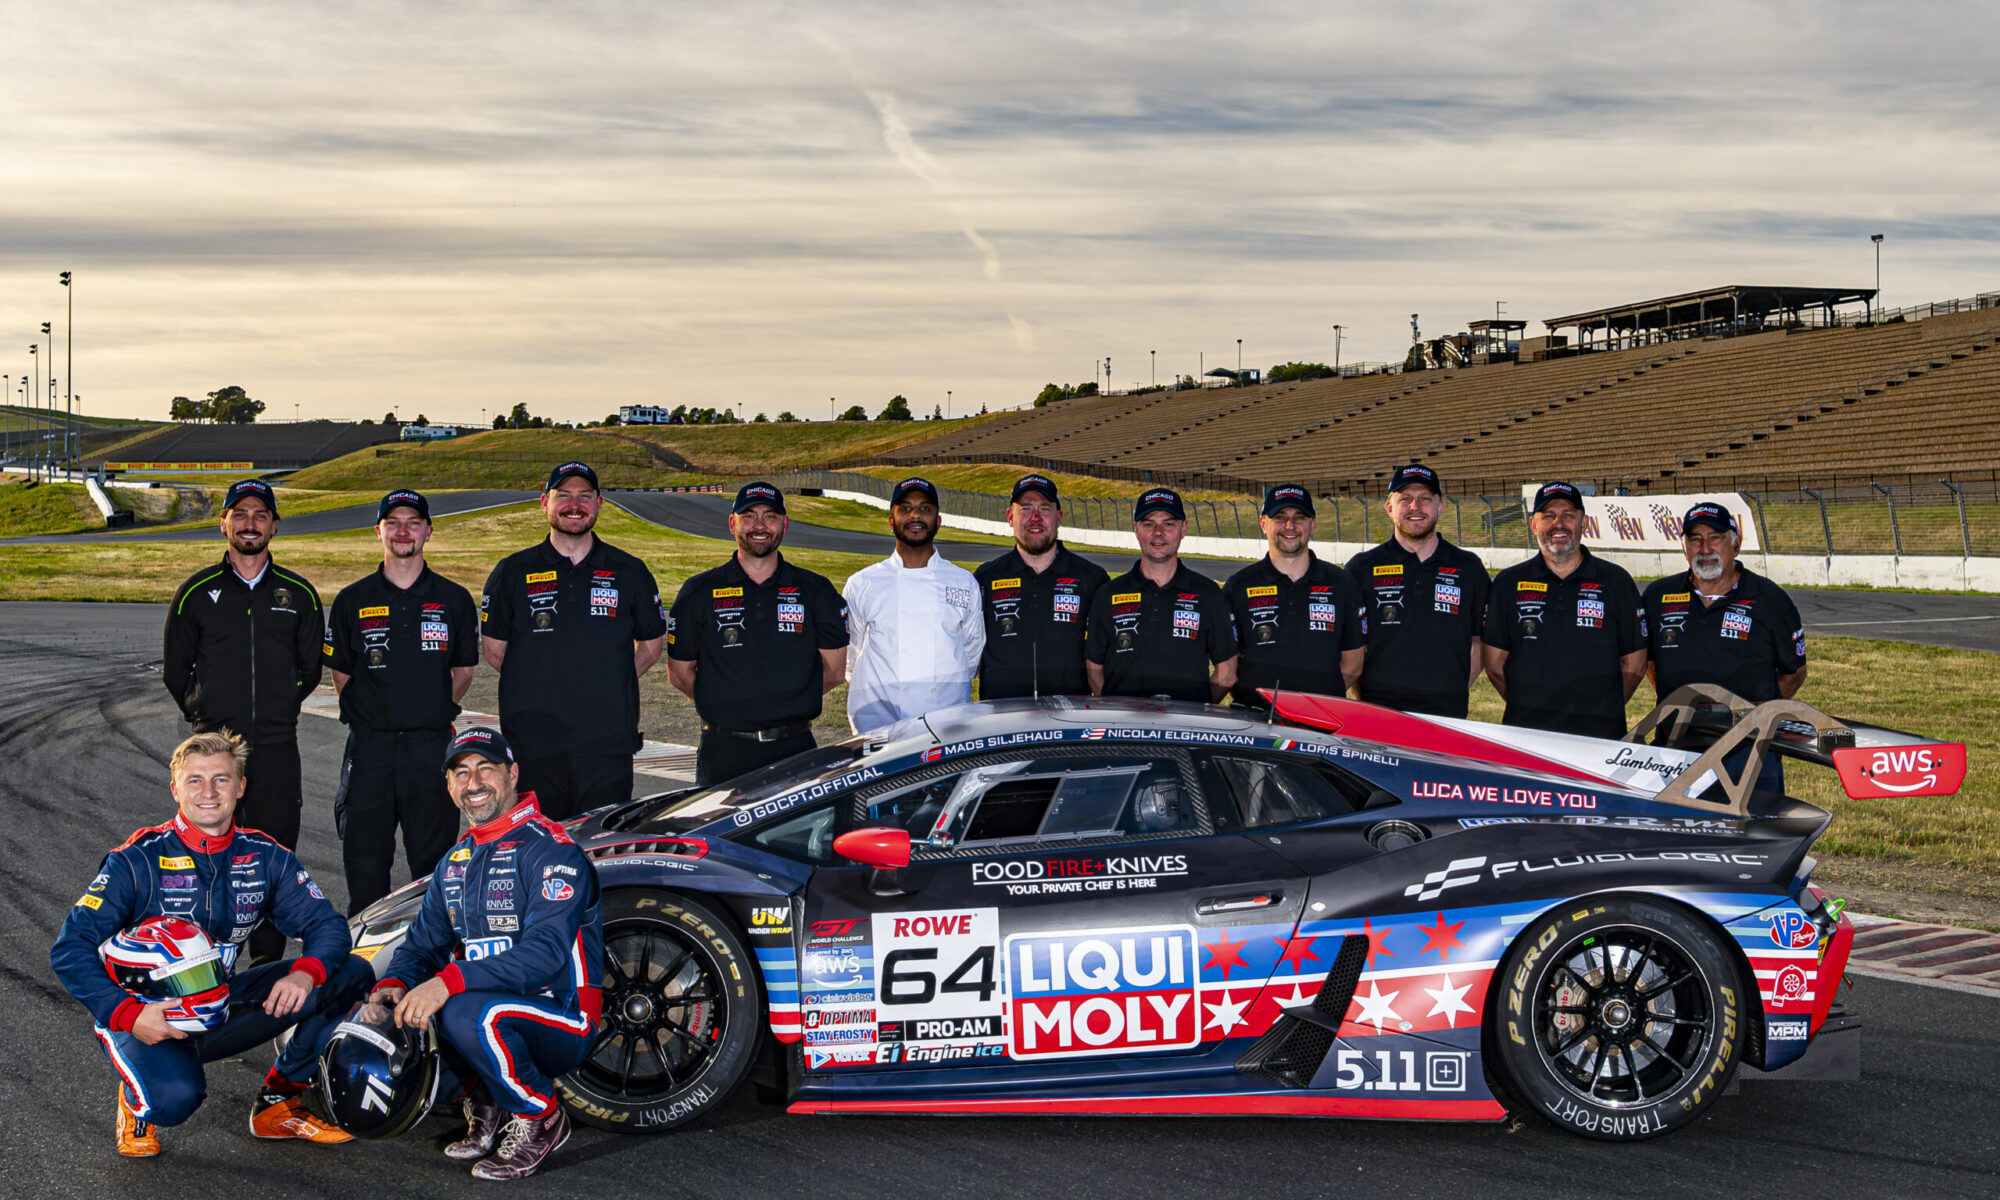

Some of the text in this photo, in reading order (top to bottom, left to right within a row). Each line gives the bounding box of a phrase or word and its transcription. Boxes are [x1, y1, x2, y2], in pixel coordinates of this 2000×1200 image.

[560, 462, 588, 473] CHICAGO
[1402, 468, 1432, 477] CHICAGO
[236, 482, 266, 490] CHICAGO
[746, 486, 776, 496] CHICAGO
[388, 492, 419, 502] CHICAGO
[1145, 492, 1174, 501] CHICAGO
[1274, 488, 1304, 496] CHICAGO
[592, 589, 616, 598] LIQUI
[1437, 586, 1459, 595] LIQUI
[592, 597, 617, 606] MOLY
[1056, 596, 1078, 604] LIQUI
[1436, 594, 1458, 603] MOLY
[1056, 604, 1079, 612] MOLY
[1311, 605, 1334, 613] LIQUI
[1580, 602, 1602, 610] LIQUI
[780, 612, 802, 621] MOLY
[1176, 612, 1198, 620] LIQUI
[1310, 612, 1334, 621] MOLY
[1579, 608, 1602, 617] MOLY
[1175, 619, 1199, 628] MOLY
[1726, 614, 1750, 624] LIQUI
[424, 623, 446, 632] LIQUI
[1724, 620, 1750, 632] MOLY
[423, 632, 446, 640] MOLY
[455, 731, 492, 744] CHICAGO
[945, 730, 1063, 756] MADS SILJEHAUG
[1108, 729, 1254, 746] NICOLAI ELGHANAYAN
[1300, 744, 1400, 766] LORIS SPINELLI
[1872, 750, 1933, 774] aws
[754, 766, 884, 818] GOCPT.OFFICIAL
[1412, 781, 1598, 809] LUCA WE LOVE YOU
[1492, 852, 1768, 878] FLUIDLOGIC
[972, 860, 1044, 882] FOOD
[488, 881, 515, 891] FOOD
[1007, 878, 1157, 896] YOUR PRIVATE CHEF IS HERE
[236, 893, 264, 905] FOOD
[486, 899, 514, 908] KNIVES
[808, 918, 870, 936] GT
[894, 914, 972, 938] ROWE
[1772, 910, 1816, 949] VP Racing
[814, 956, 860, 974] aws
[1019, 936, 1185, 992] LIQUI
[880, 946, 997, 1006] 64
[824, 1010, 871, 1026] OPTIMA
[1022, 993, 1192, 1050] MOLY
[916, 1020, 991, 1038] PRO-AM
[1768, 1026, 1808, 1036] MPM
[806, 1031, 831, 1042] STAY
[833, 1028, 872, 1040] FROSTY
[1693, 986, 1737, 1104] PIRELLI
[1336, 1050, 1421, 1090] 5.11
[634, 1083, 719, 1127] TRANSPORT
[1545, 1096, 1668, 1136] TRANSPORT
